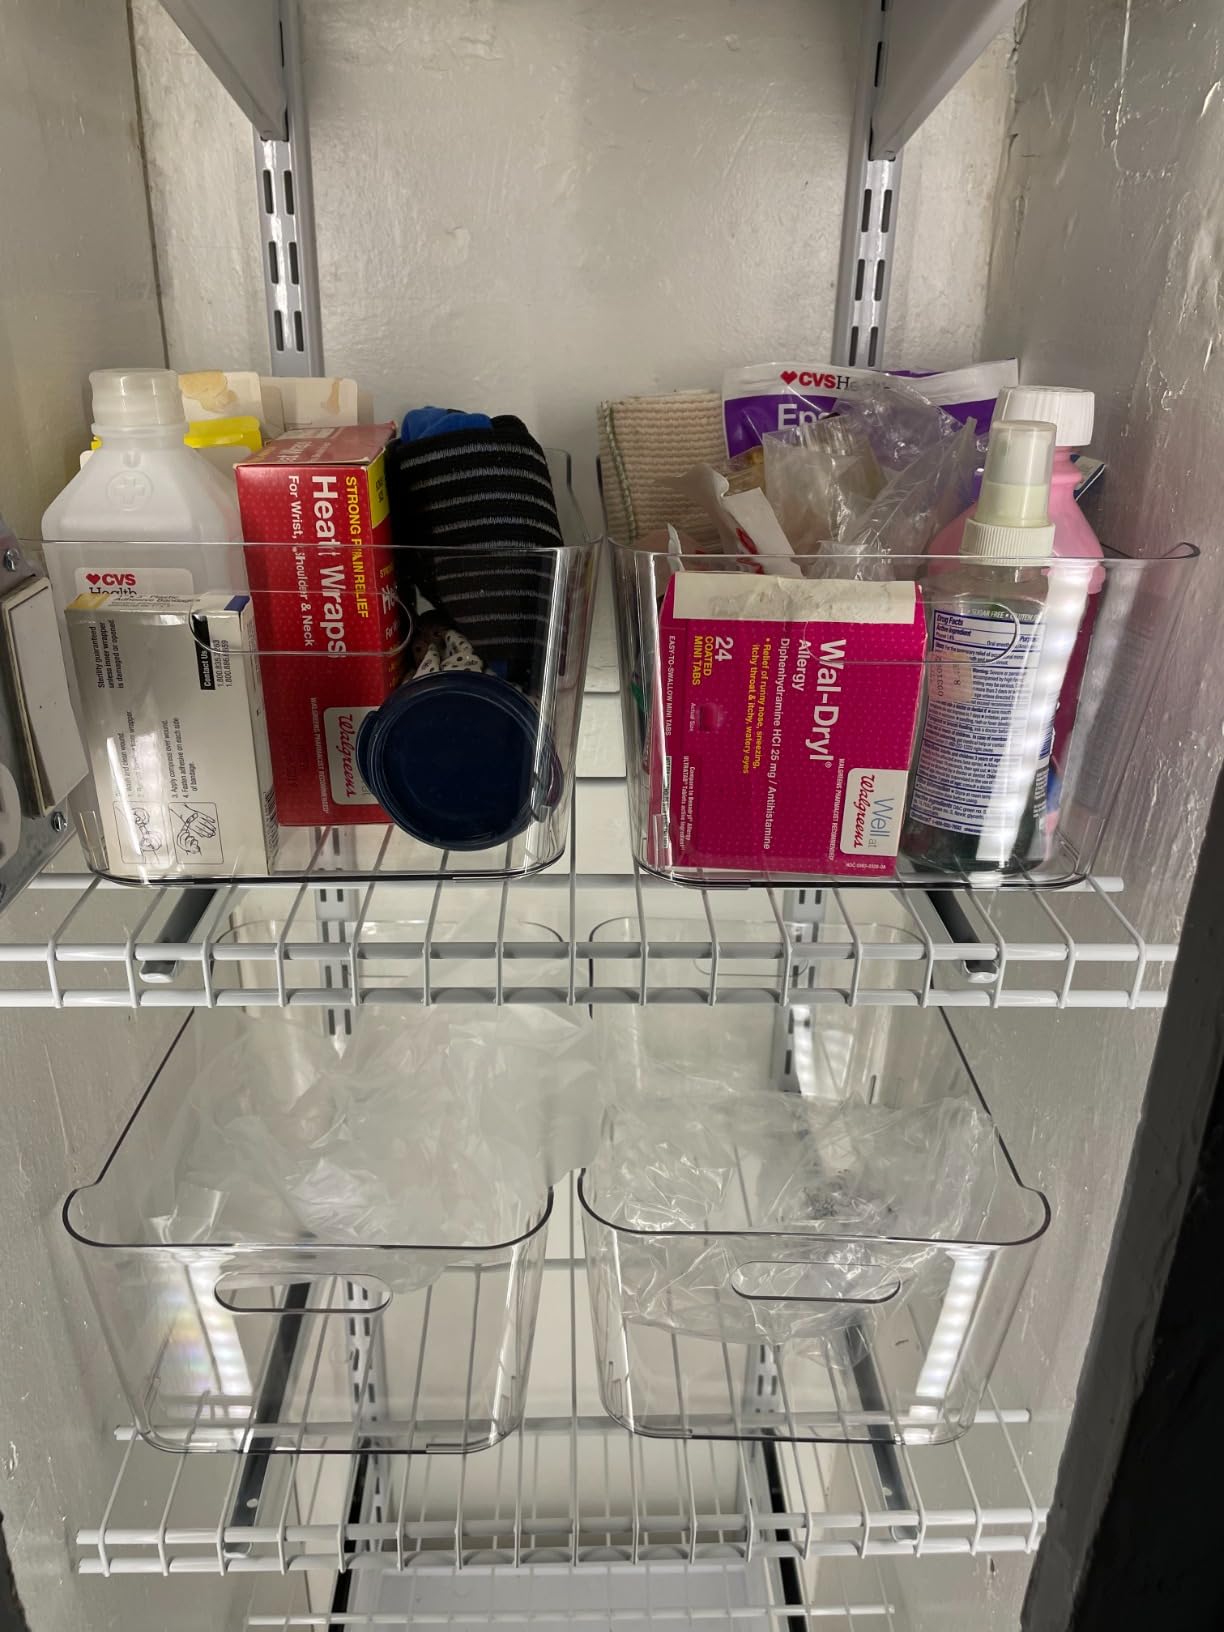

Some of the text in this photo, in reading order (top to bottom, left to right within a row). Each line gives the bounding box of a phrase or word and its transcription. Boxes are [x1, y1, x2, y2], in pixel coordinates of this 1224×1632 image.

[288, 475, 299, 497] For
[290, 501, 304, 539] Wrist,
[311, 475, 341, 557] Heat
[345, 476, 362, 535] STRONG
[102, 573, 136, 586] CVS
[353, 574, 369, 618] RELIEF
[301, 602, 312, 612] &
[319, 565, 347, 658] Wraps
[936, 615, 963, 626] Drug Facts
[991, 610, 1005, 618] FREE
[100, 622, 109, 649] wrapper
[302, 615, 315, 647] Neck
[715, 636, 734, 662] 24
[90, 626, 105, 688] Sterility guaranteed
[113, 653, 123, 682] damaged
[200, 650, 211, 687] Contact Us
[666, 635, 675, 701] EASY-TO-SWALLOW
[692, 635, 703, 686] MINI TABS
[703, 636, 714, 676] COATED
[792, 639, 812, 692] Allergy
[106, 668, 114, 688] unless
[774, 638, 790, 727] Diphenhydramine
[742, 644, 759, 774] itchy throat & itchy, watery eyes
[753, 644, 771, 769] Relief of runny nose, sneezing,
[167, 752, 175, 778] compress
[336, 713, 357, 798] Walgreens
[767, 763, 777, 778] mg
[770, 749, 780, 761] 25
[170, 778, 178, 793] Apply
[763, 786, 777, 850] Antihistamine
[853, 774, 875, 848] Walgreens
[869, 798, 894, 837] Well
[867, 839, 877, 848] at
